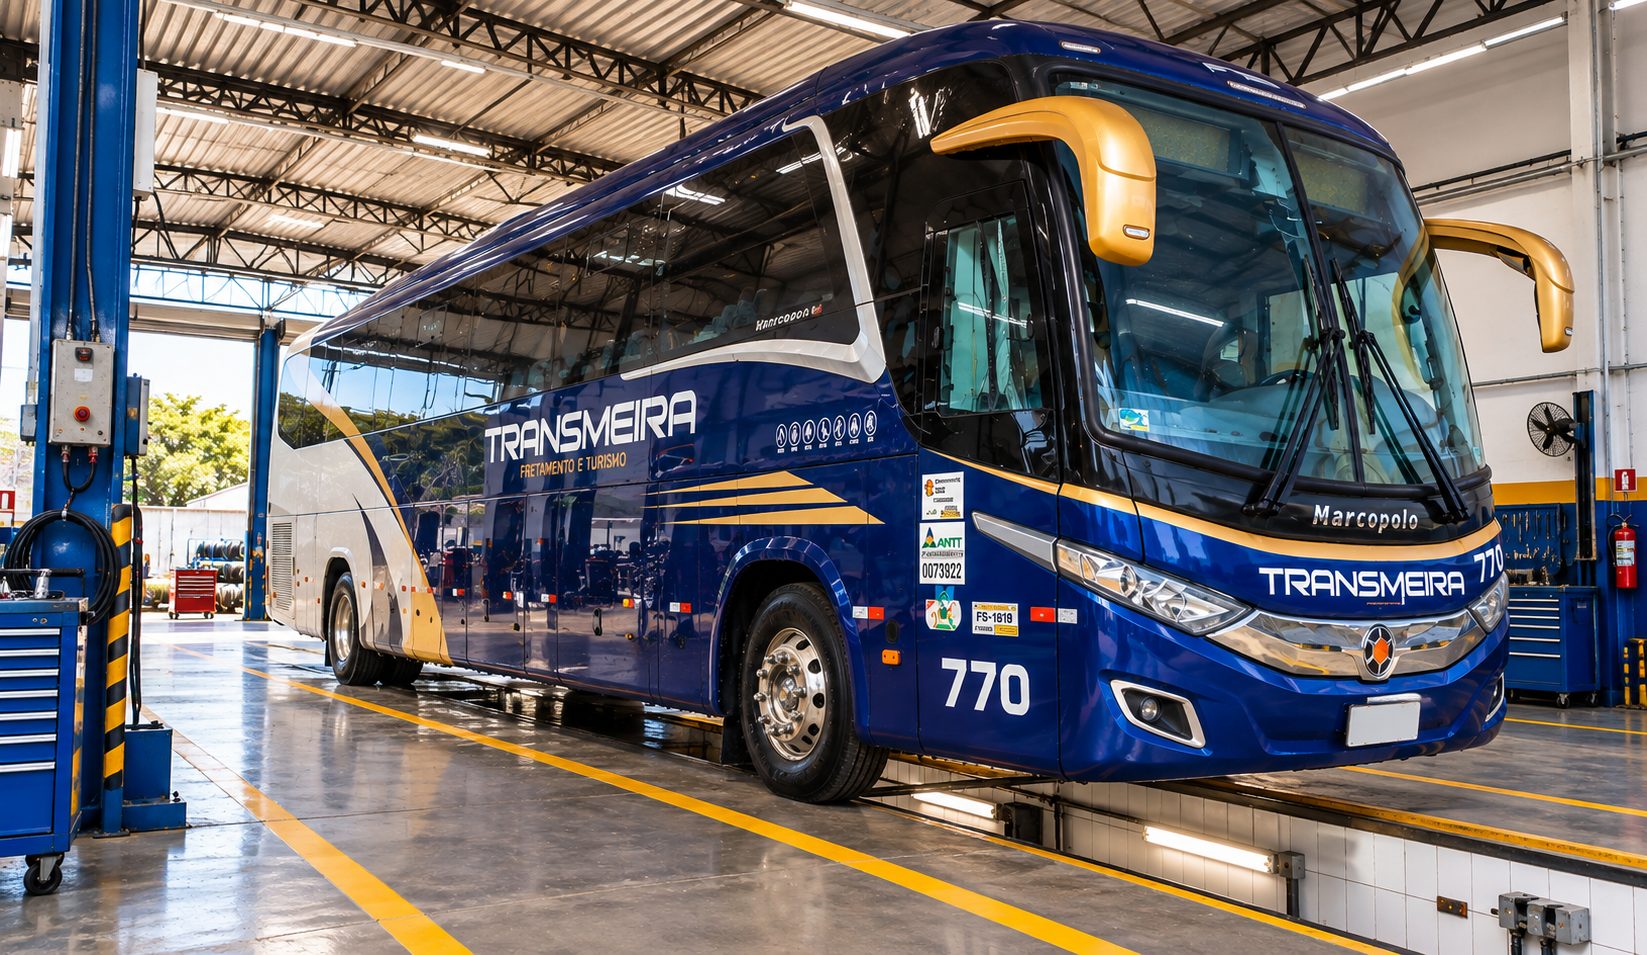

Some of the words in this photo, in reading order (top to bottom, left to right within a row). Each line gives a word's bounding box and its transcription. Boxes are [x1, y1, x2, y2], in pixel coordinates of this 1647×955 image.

[484, 389, 698, 464] TRANSMEIRA
[519, 459, 575, 479] FRETAMENTO
[577, 460, 583, 472] E
[586, 451, 627, 471] TURISMO
[1312, 504, 1419, 534] Marcopolo
[937, 537, 963, 548] ANTT
[1473, 543, 1504, 584] 770
[1258, 567, 1466, 605] TRANSMEIRA
[941, 657, 1031, 716] 770
